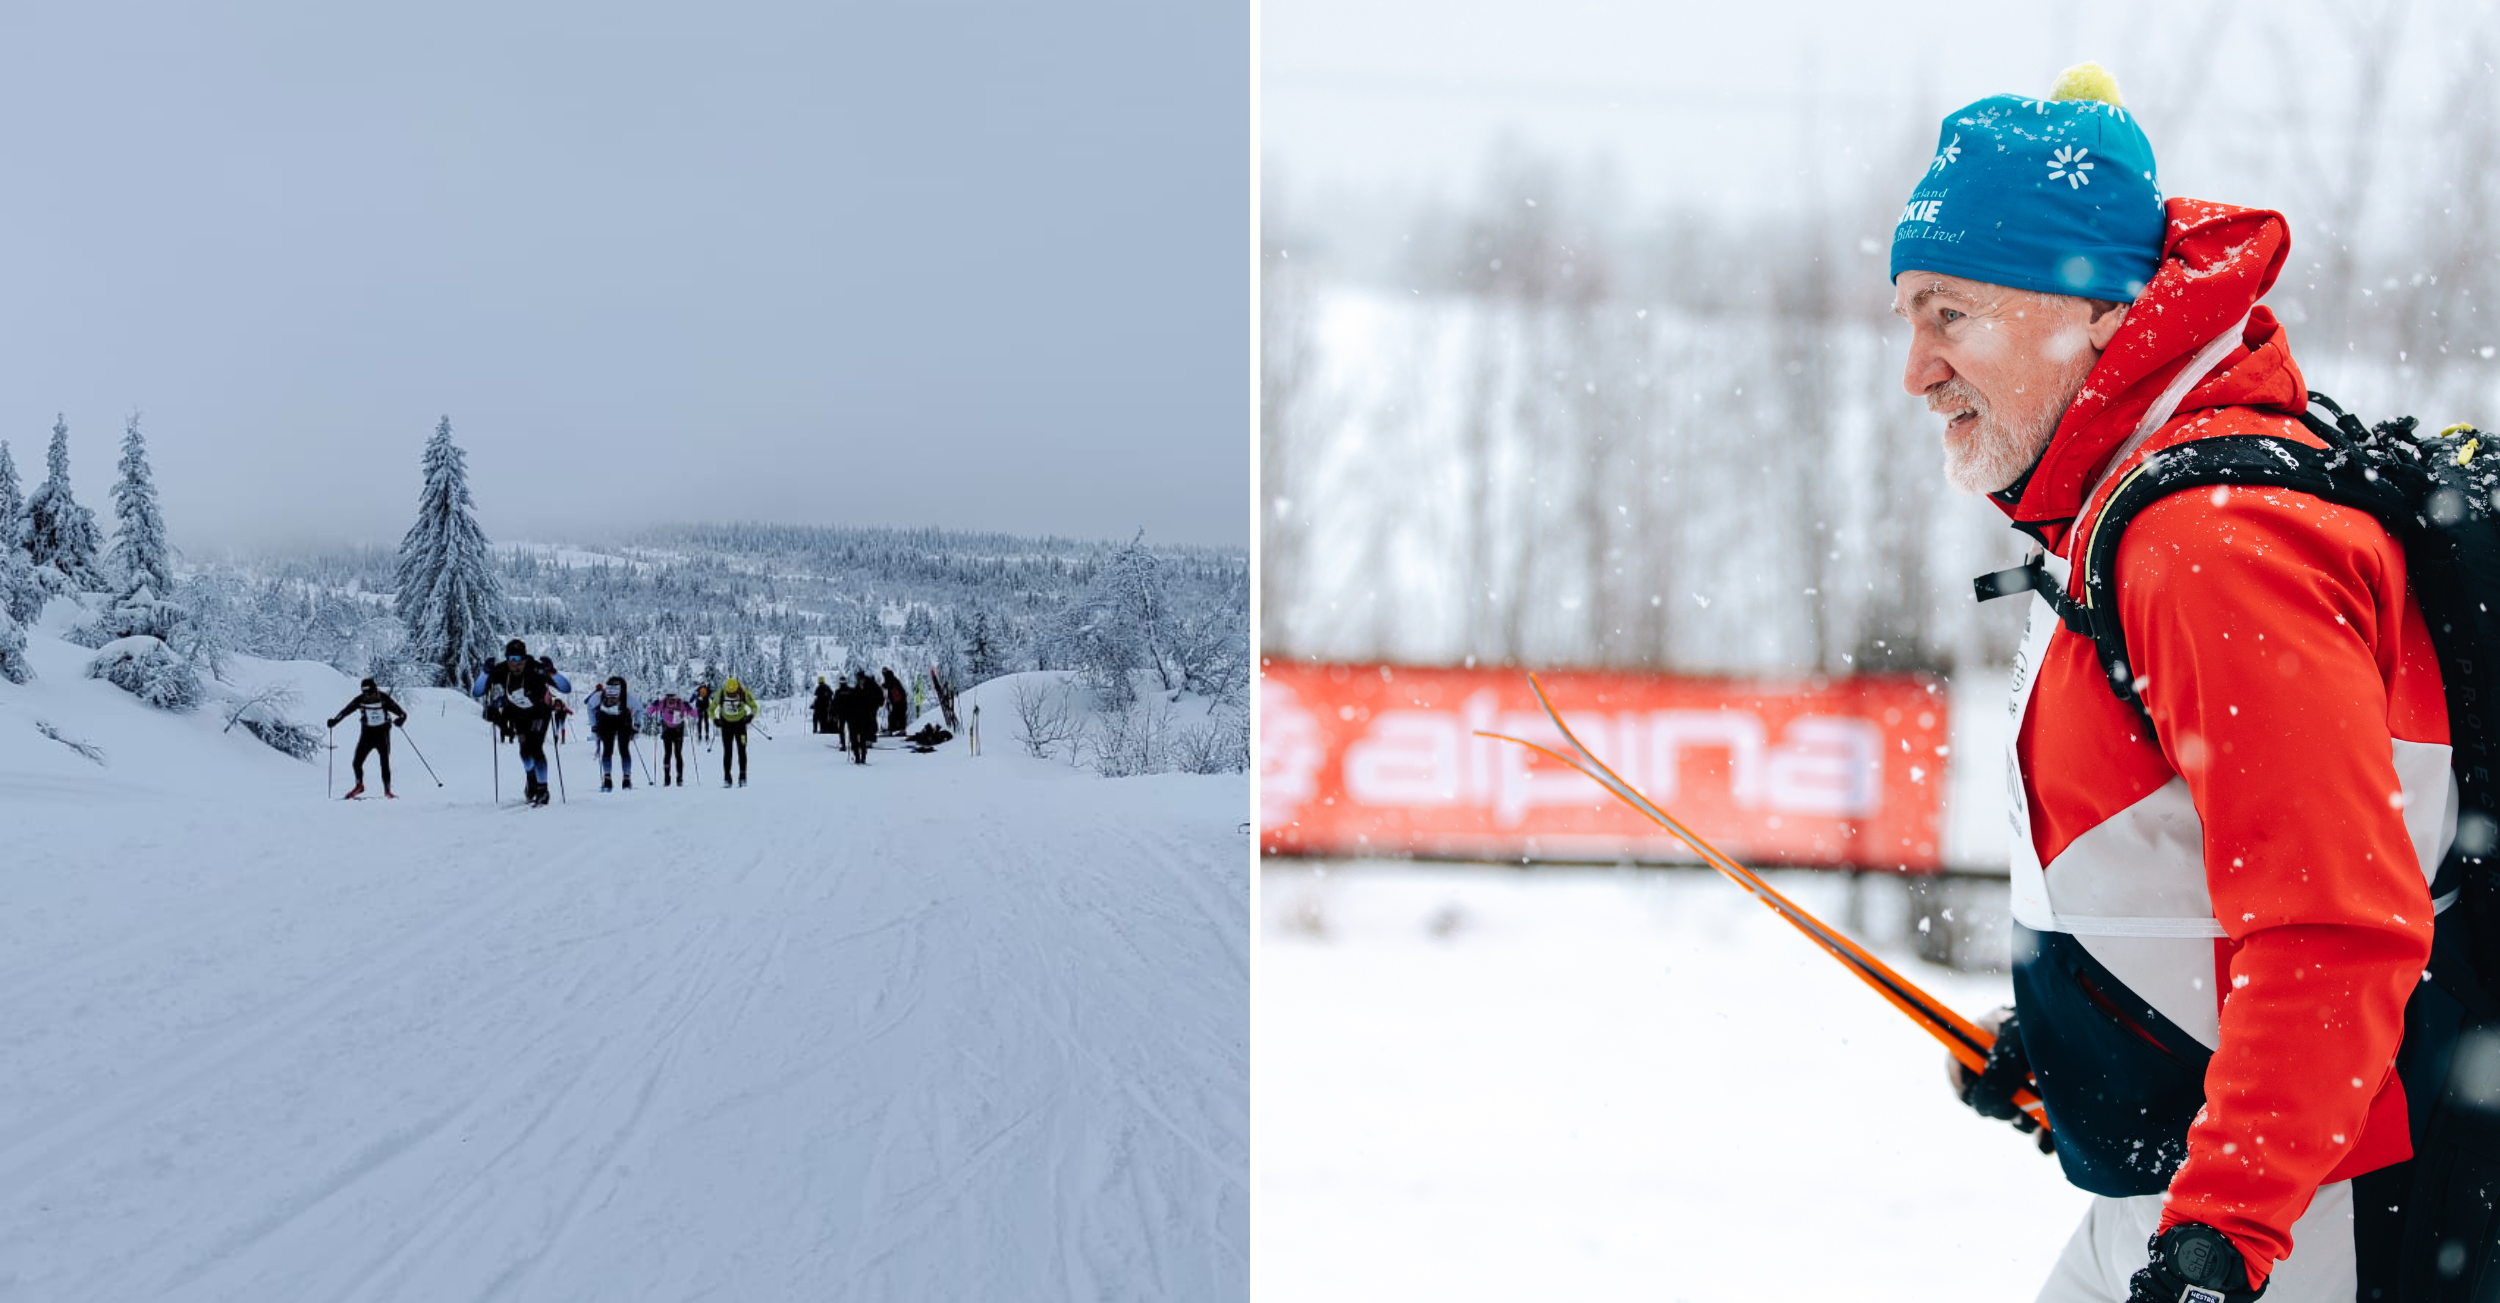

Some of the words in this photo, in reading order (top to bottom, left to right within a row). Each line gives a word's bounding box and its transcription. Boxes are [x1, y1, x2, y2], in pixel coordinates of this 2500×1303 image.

[1897, 225, 1919, 242] Bike.
[1921, 226, 1965, 243] Live!
[1342, 687, 1886, 829] alpina
[2456, 658, 2500, 888] PROTECTOR
